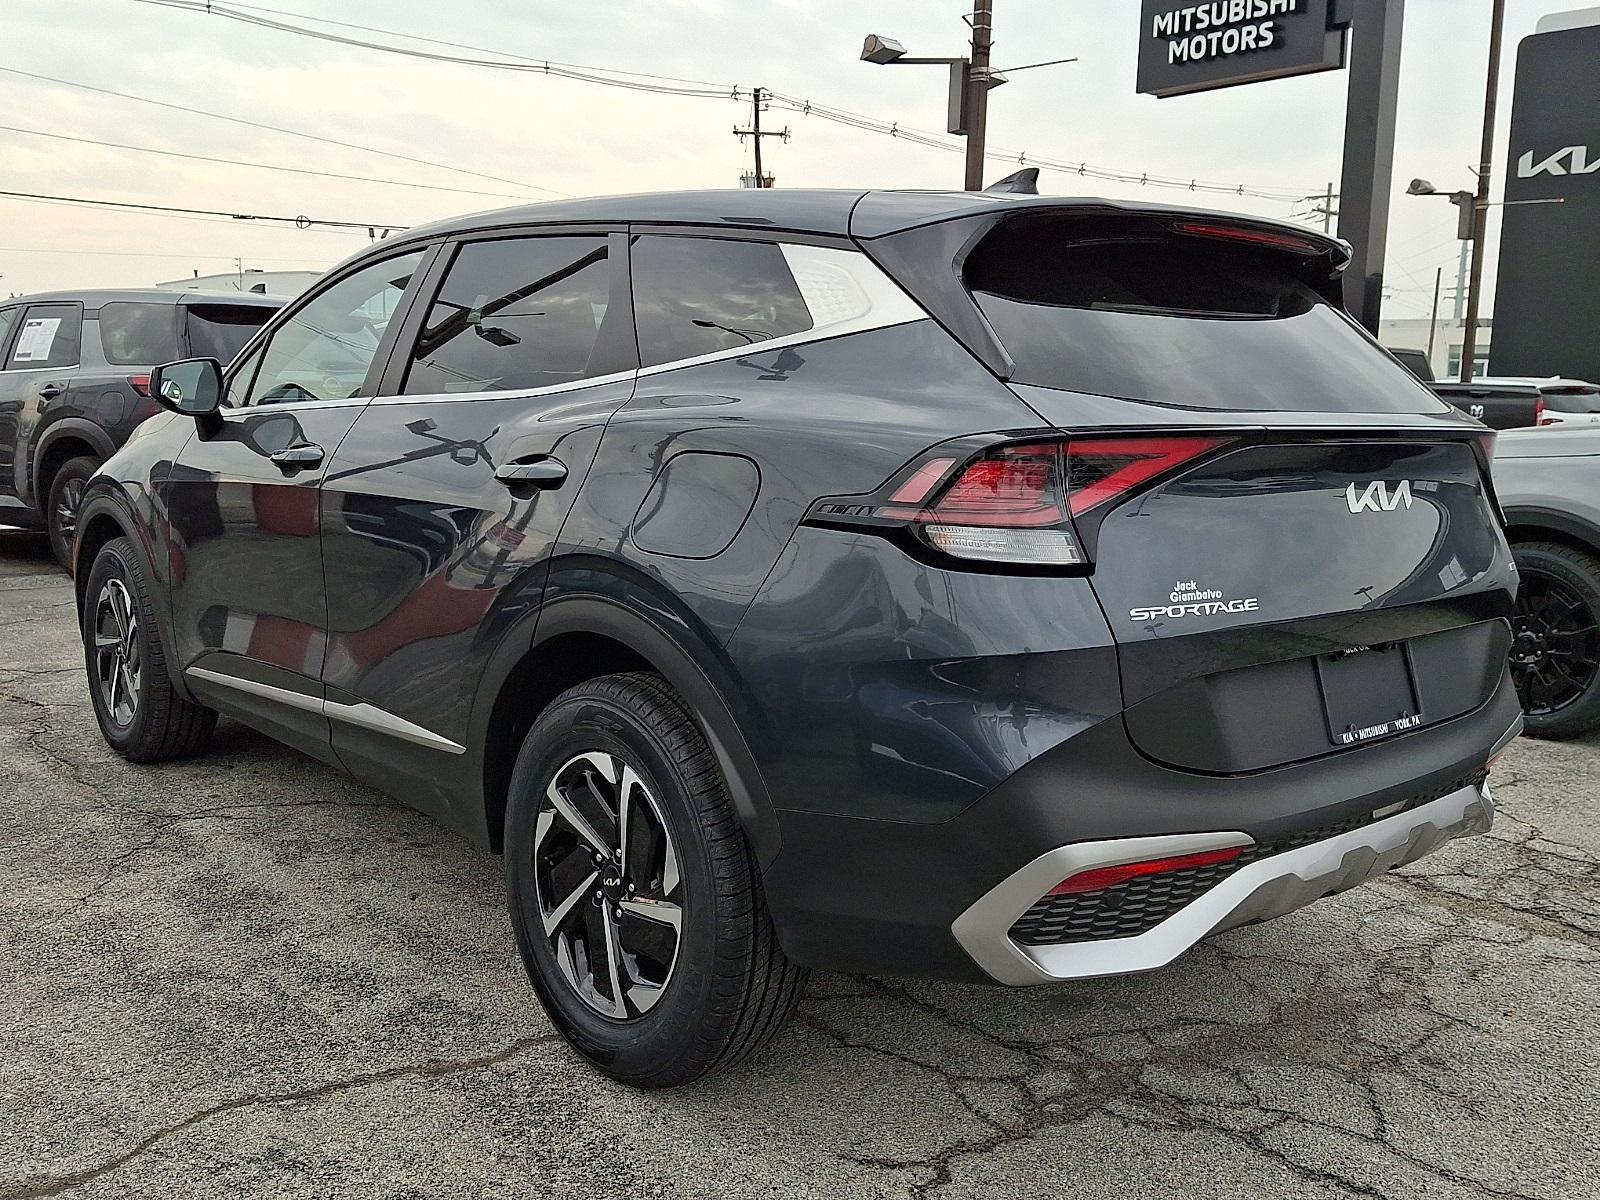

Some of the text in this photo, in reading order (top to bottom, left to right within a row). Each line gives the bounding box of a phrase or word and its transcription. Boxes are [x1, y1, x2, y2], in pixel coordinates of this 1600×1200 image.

[1153, 0, 1296, 39] MITSUBISHI
[1168, 21, 1274, 64] MOTORS
[1347, 480, 1412, 513] KIA
[1169, 589, 1223, 603] Giambalvo
[1173, 580, 1198, 592] Jack
[1130, 598, 1259, 621] SPORTAGE
[1343, 734, 1354, 744] KIA
[1359, 724, 1388, 740] MITSUBISHI
[603, 878, 621, 887] KIA
